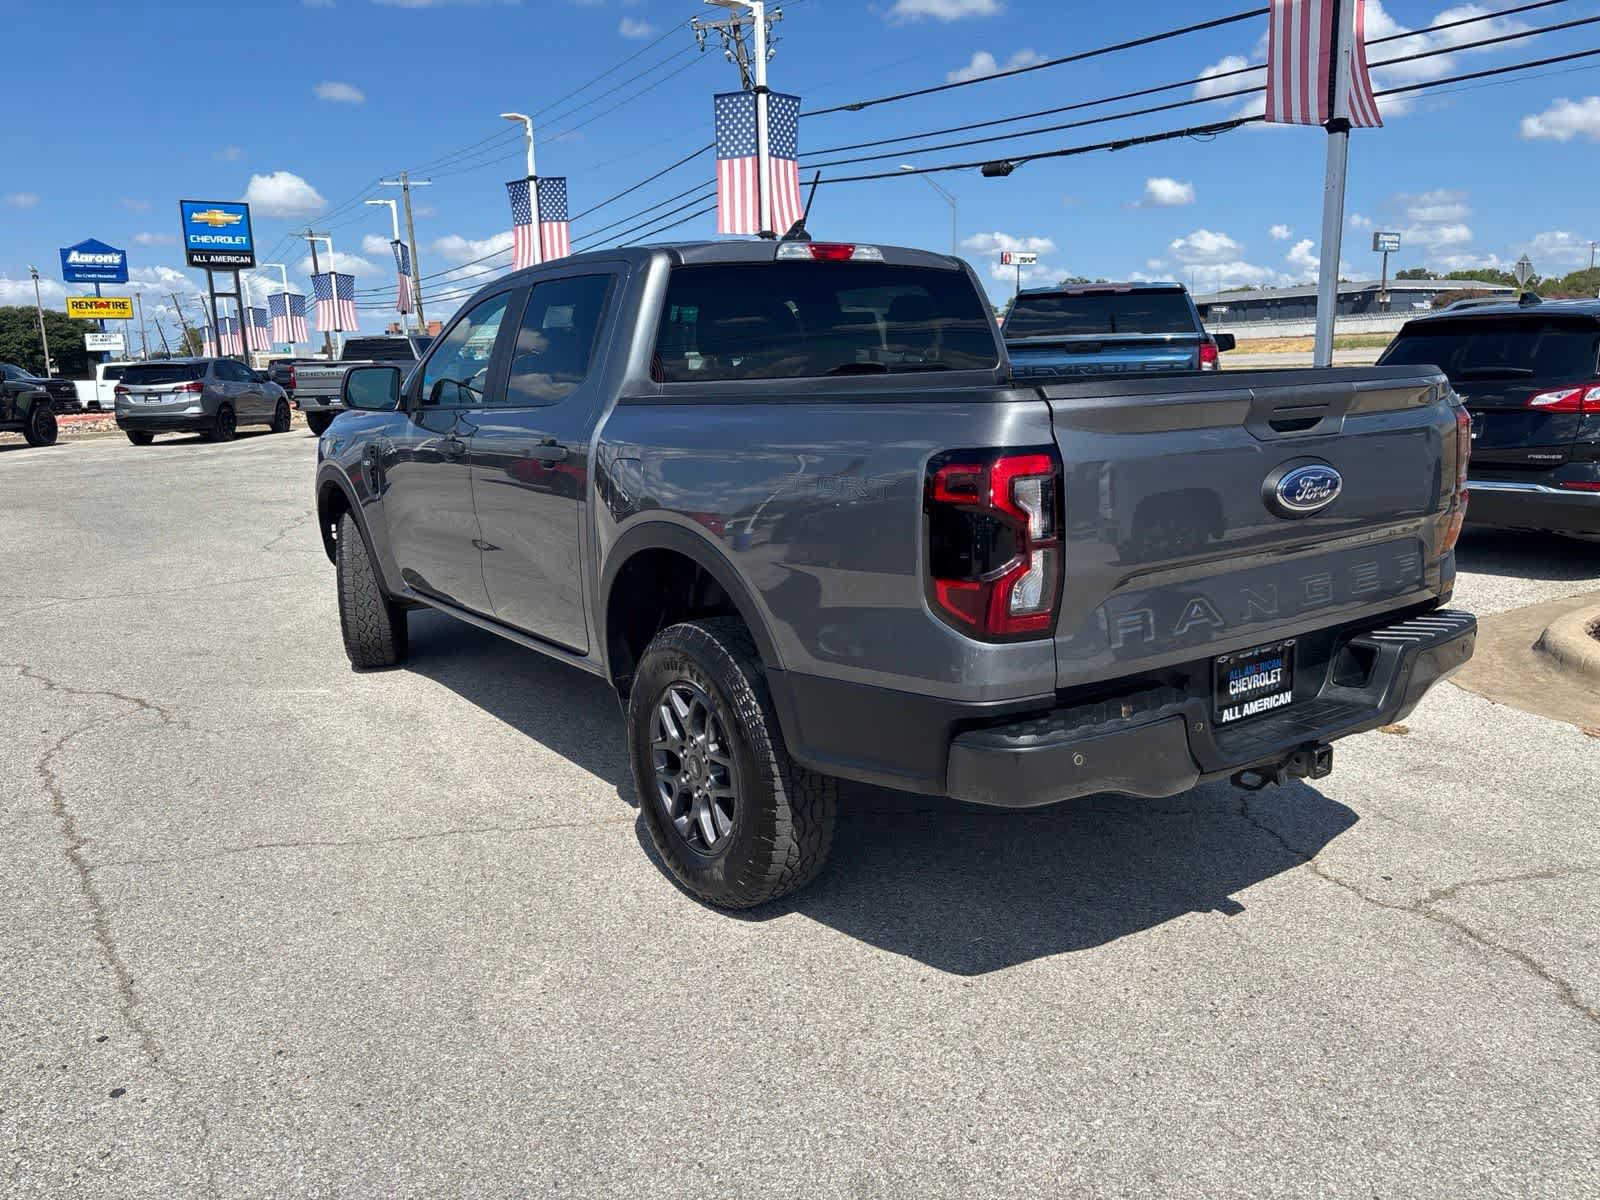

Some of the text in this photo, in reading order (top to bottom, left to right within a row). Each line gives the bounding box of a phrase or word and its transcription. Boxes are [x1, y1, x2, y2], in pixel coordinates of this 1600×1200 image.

[190, 235, 247, 245] CHEVROLET
[67, 251, 122, 265] Aaron's
[193, 255, 251, 264] ALL AMERICAN
[106, 301, 129, 310] TIRE
[1295, 475, 1331, 502] Ford
[1229, 658, 1282, 681] ALL AMERICAN
[1229, 668, 1282, 696] CHEVROLET
[1222, 691, 1292, 723] ALL AMERICAN
